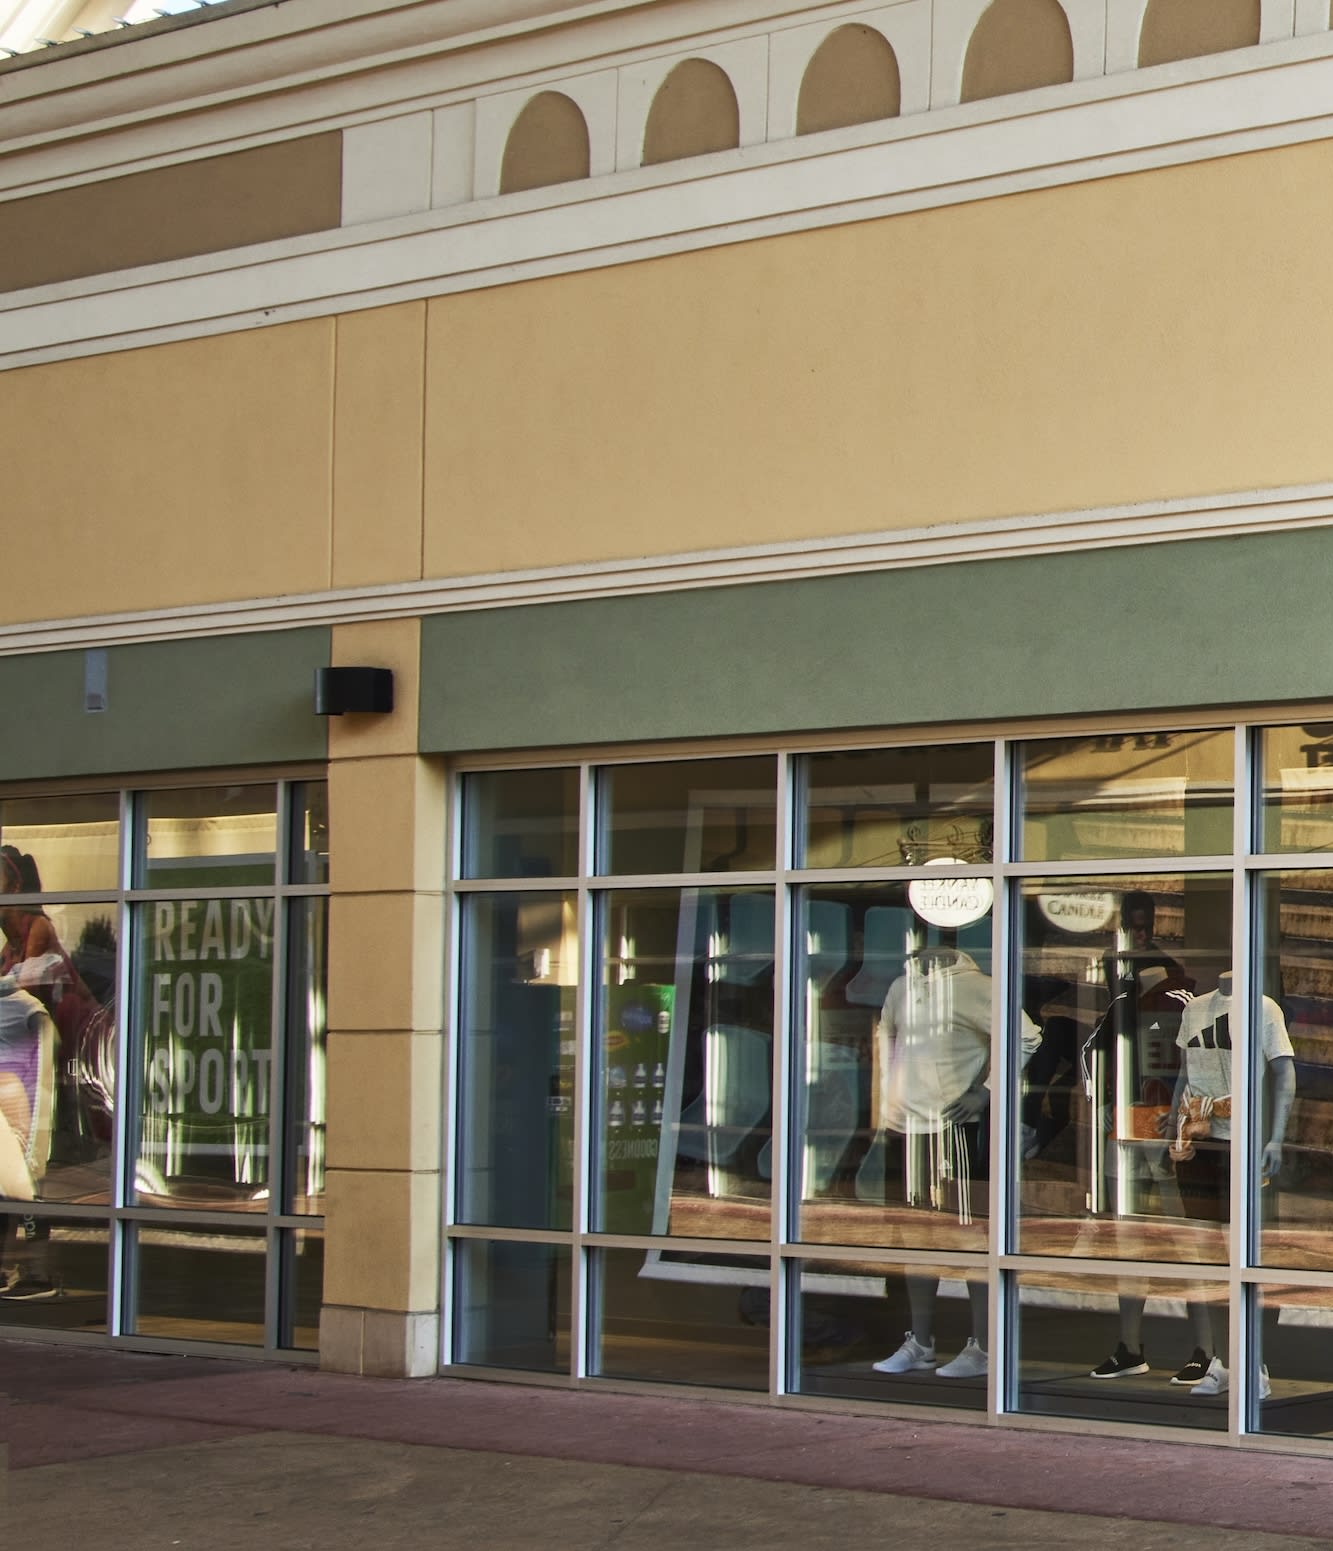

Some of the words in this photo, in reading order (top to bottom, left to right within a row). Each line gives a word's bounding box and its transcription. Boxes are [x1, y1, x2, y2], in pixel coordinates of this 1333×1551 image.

[154, 899, 275, 961] READY
[153, 972, 223, 1038] FOR
[149, 1048, 273, 1115] SPORT
